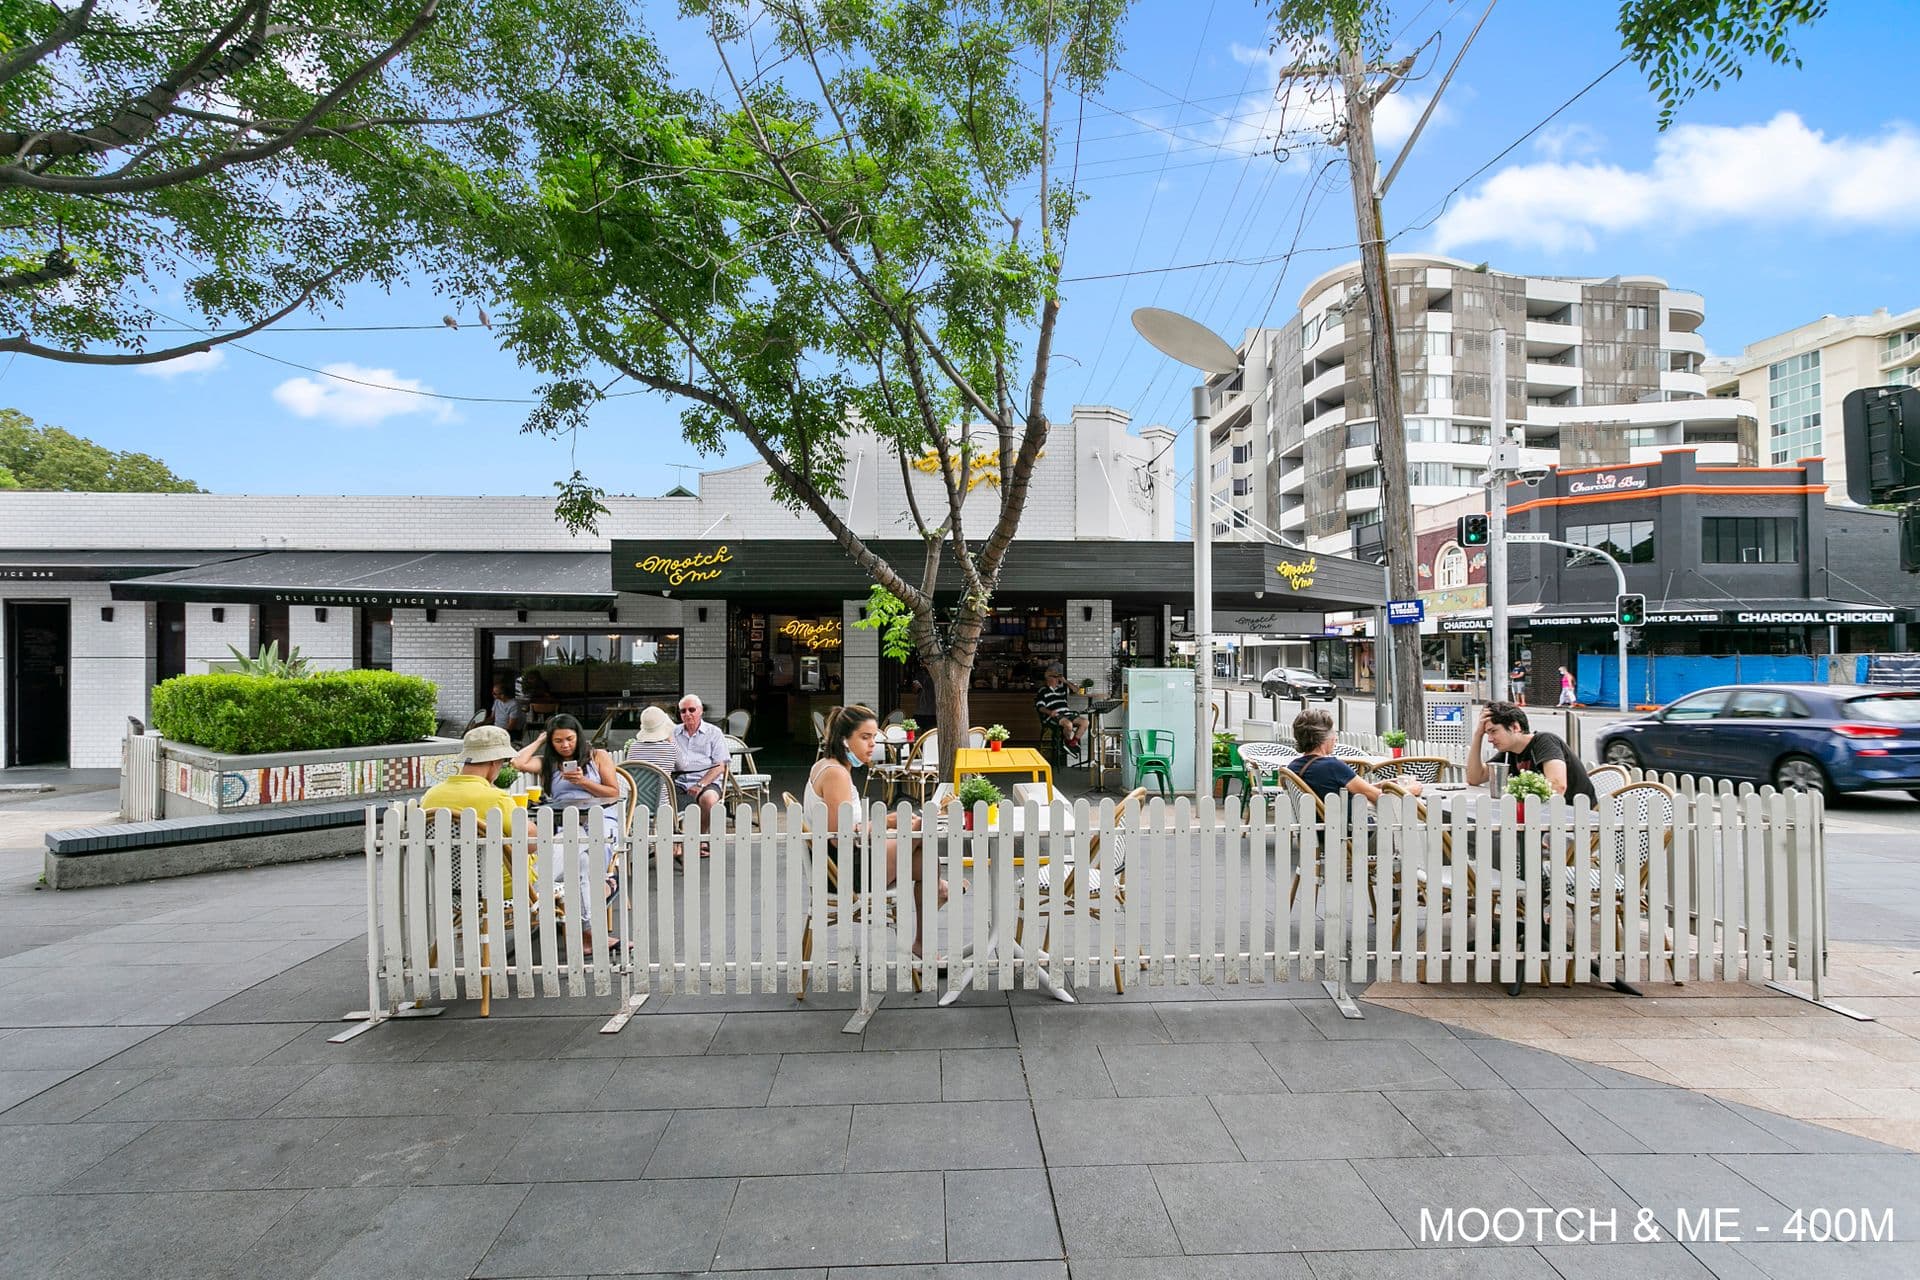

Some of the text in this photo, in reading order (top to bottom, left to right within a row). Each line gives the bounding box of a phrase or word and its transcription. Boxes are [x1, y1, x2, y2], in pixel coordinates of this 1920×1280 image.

[1570, 475, 1646, 493] Charcoal Bay
[635, 545, 733, 576] Mootch
[314, 595, 378, 604] ESPRESSO
[387, 597, 425, 605] JUICE
[1529, 617, 1582, 626] BURGERS
[1668, 614, 1719, 623] PLATES
[1737, 612, 1895, 623] CHARCOAL CHICKEN
[1443, 621, 1486, 630] CHARCOAL
